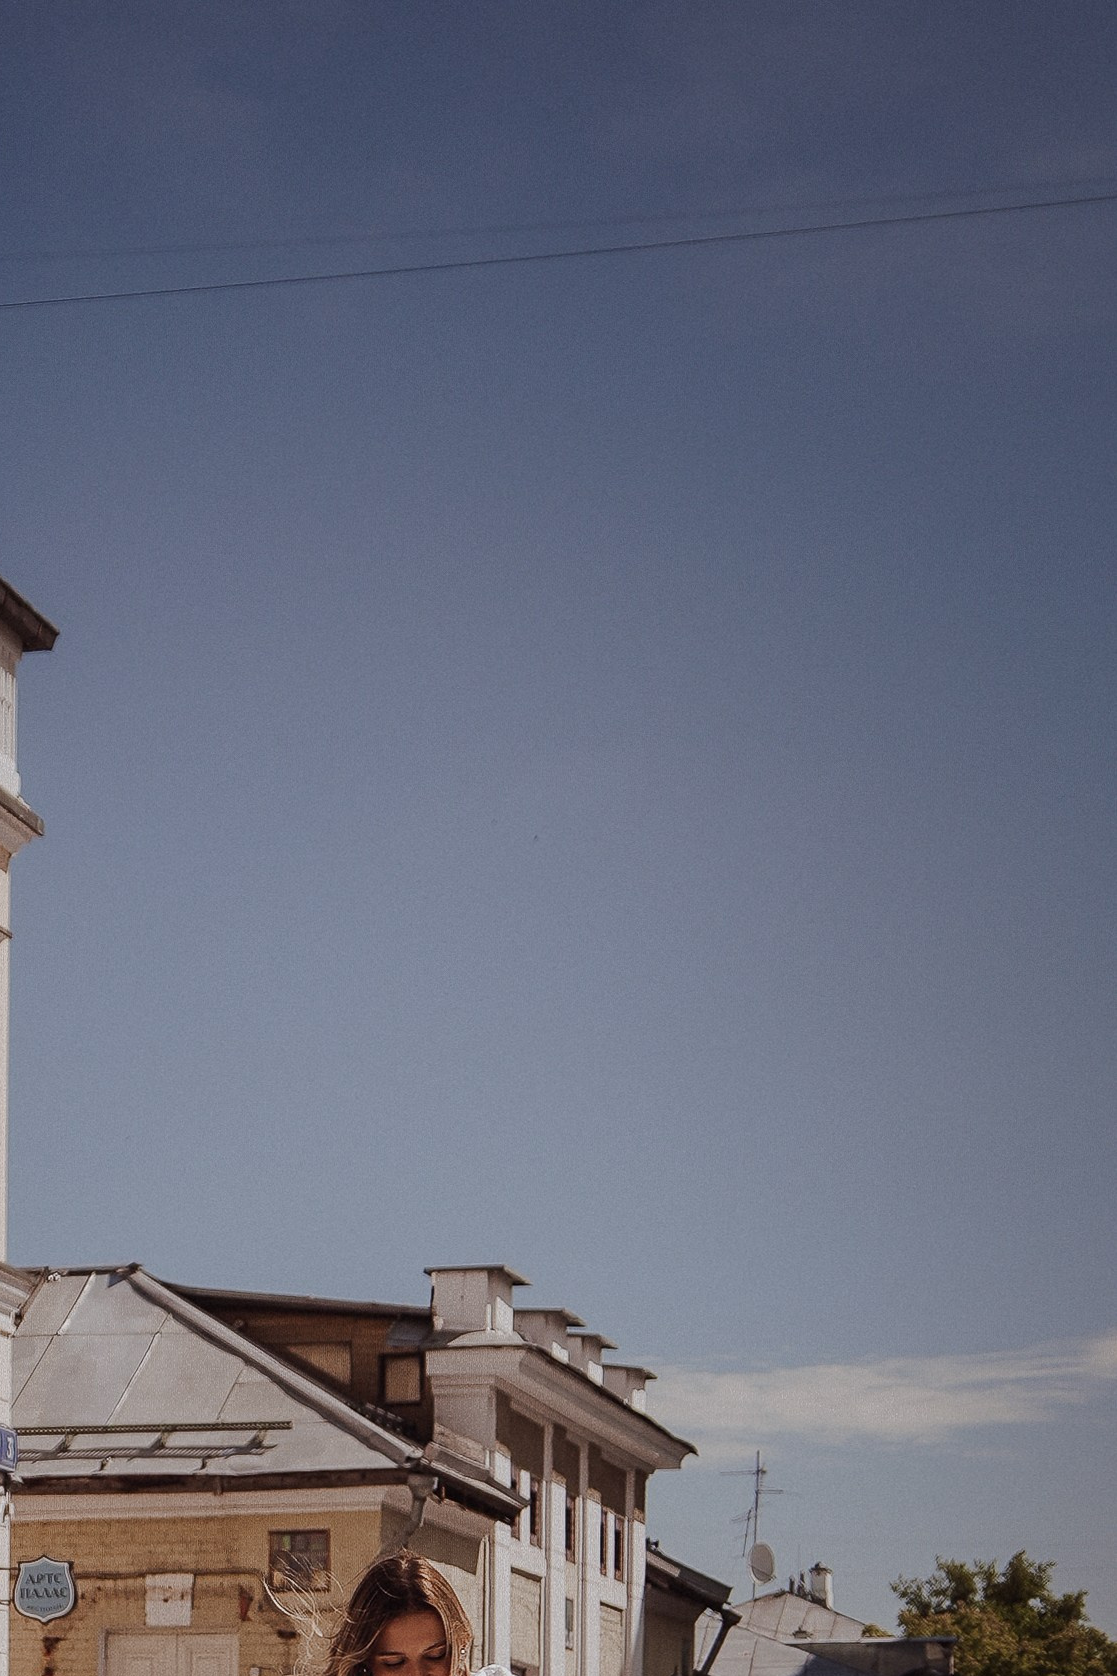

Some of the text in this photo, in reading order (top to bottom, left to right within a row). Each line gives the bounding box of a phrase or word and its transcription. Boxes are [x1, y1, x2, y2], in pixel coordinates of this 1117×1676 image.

[6, 1436, 15, 1460] 3
[25, 1572, 62, 1585] АРТС
[20, 1586, 68, 1599] ПАЛАС
